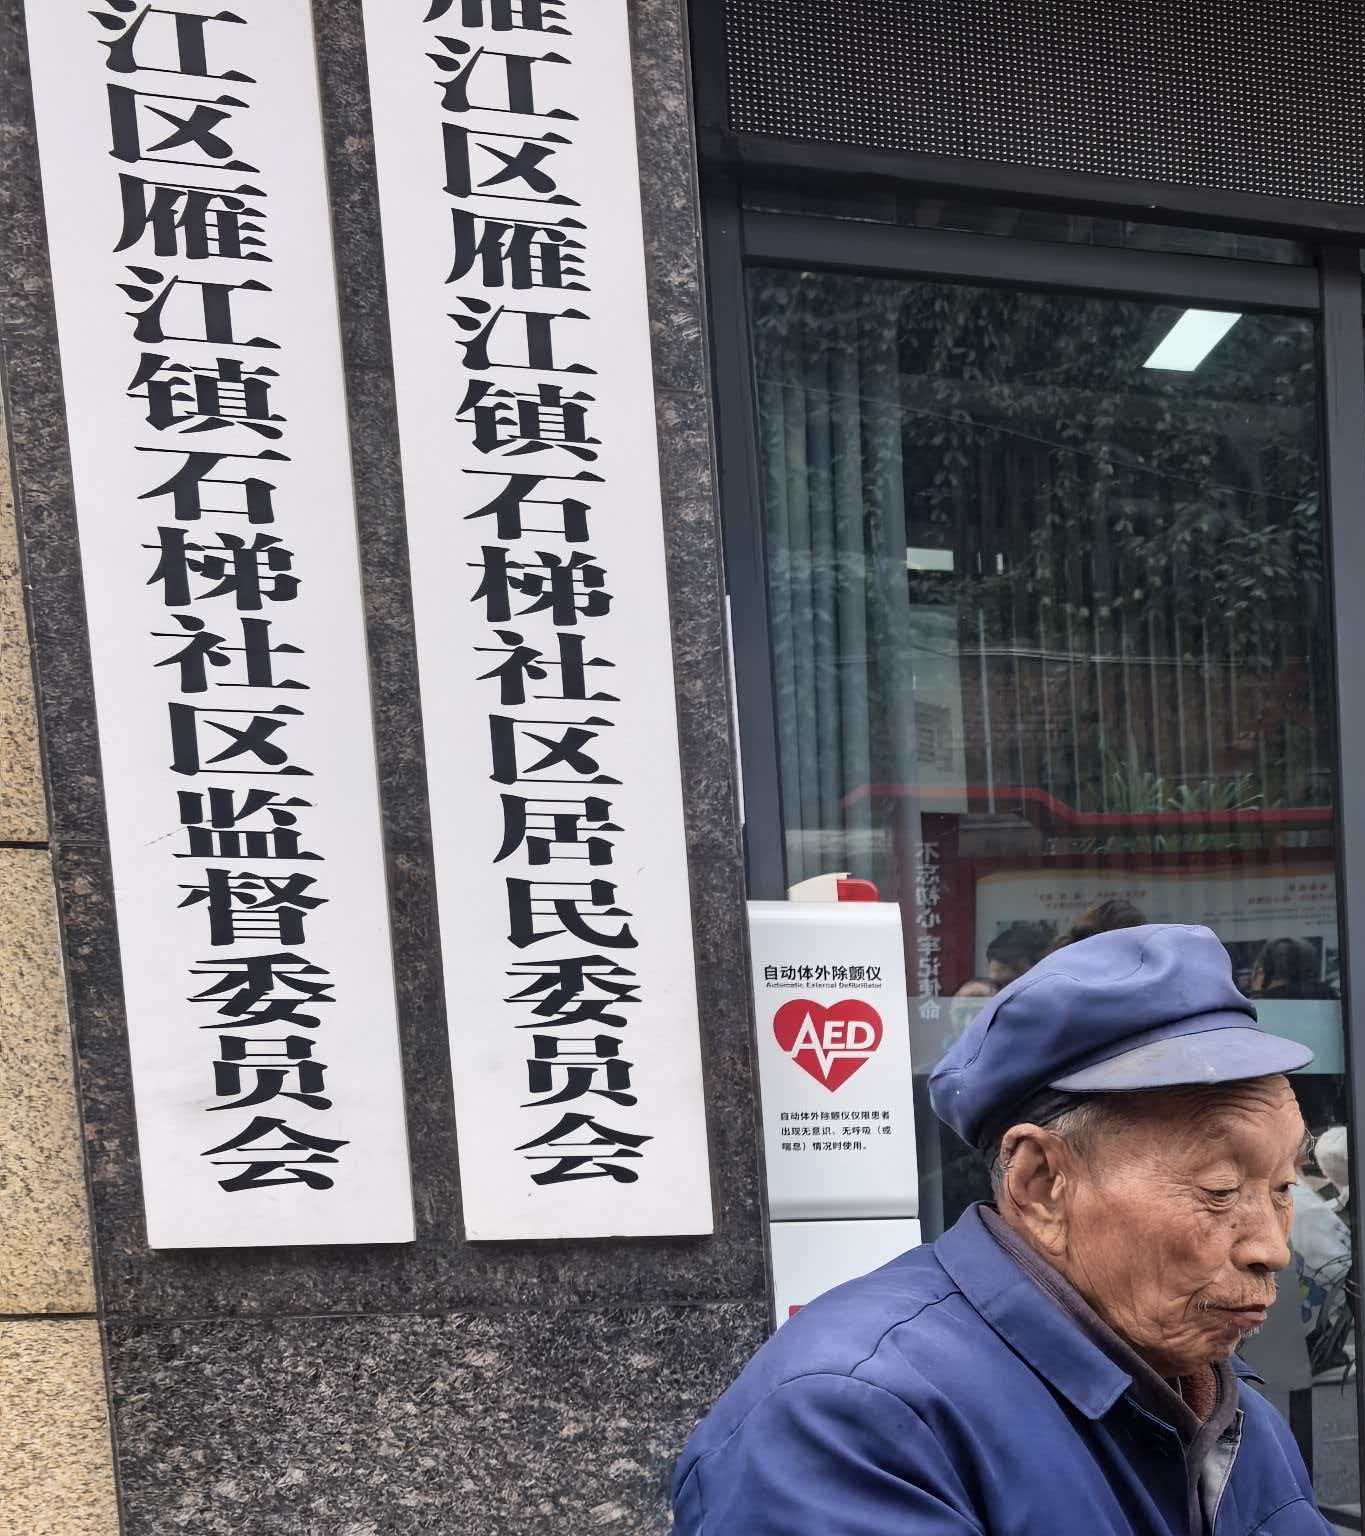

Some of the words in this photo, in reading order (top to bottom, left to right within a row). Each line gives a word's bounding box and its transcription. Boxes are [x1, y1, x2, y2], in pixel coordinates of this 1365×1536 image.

[90, 0, 350, 1193] 江区雁江镇石梯社区监督委员会
[764, 965, 882, 981] 自动体外除颤仪
[790, 1010, 876, 1060] AED
